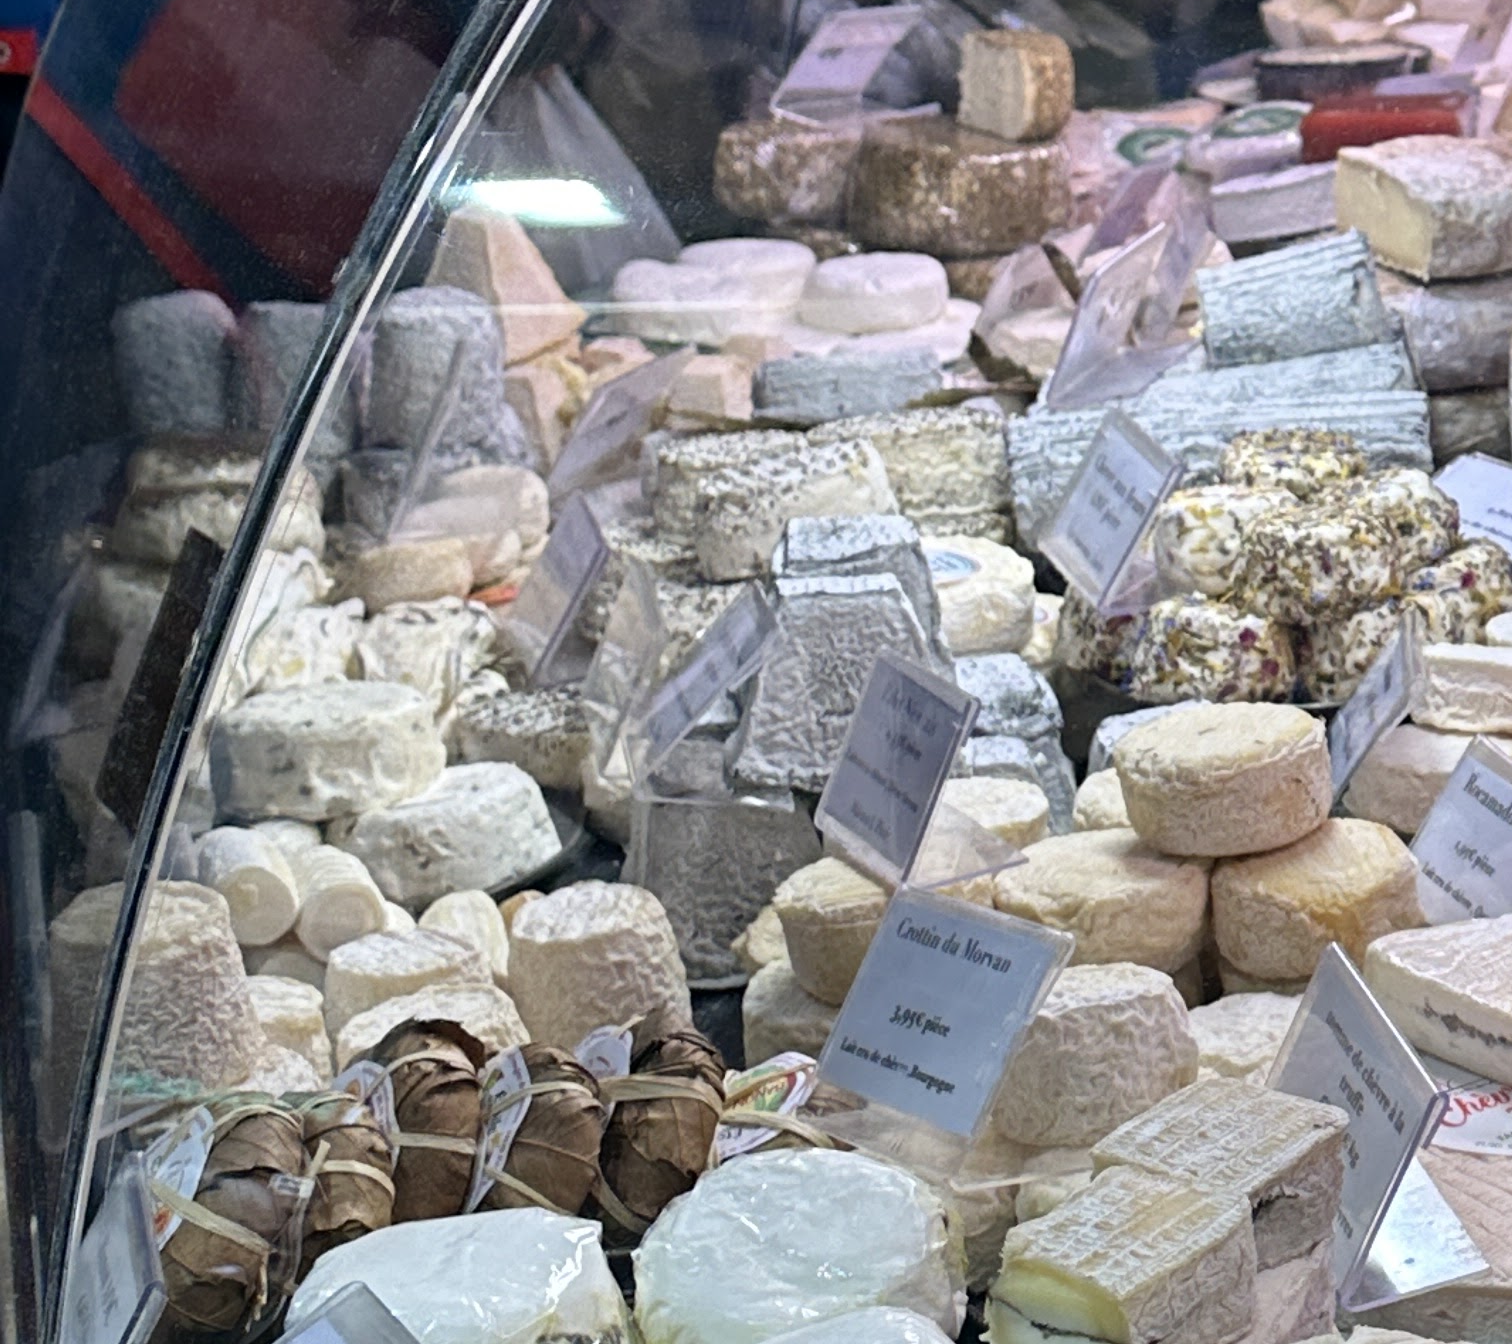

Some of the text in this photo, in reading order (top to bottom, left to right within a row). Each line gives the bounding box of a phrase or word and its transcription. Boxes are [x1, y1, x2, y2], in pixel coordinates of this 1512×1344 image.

[897, 917, 1012, 973] Crottin du Morvan
